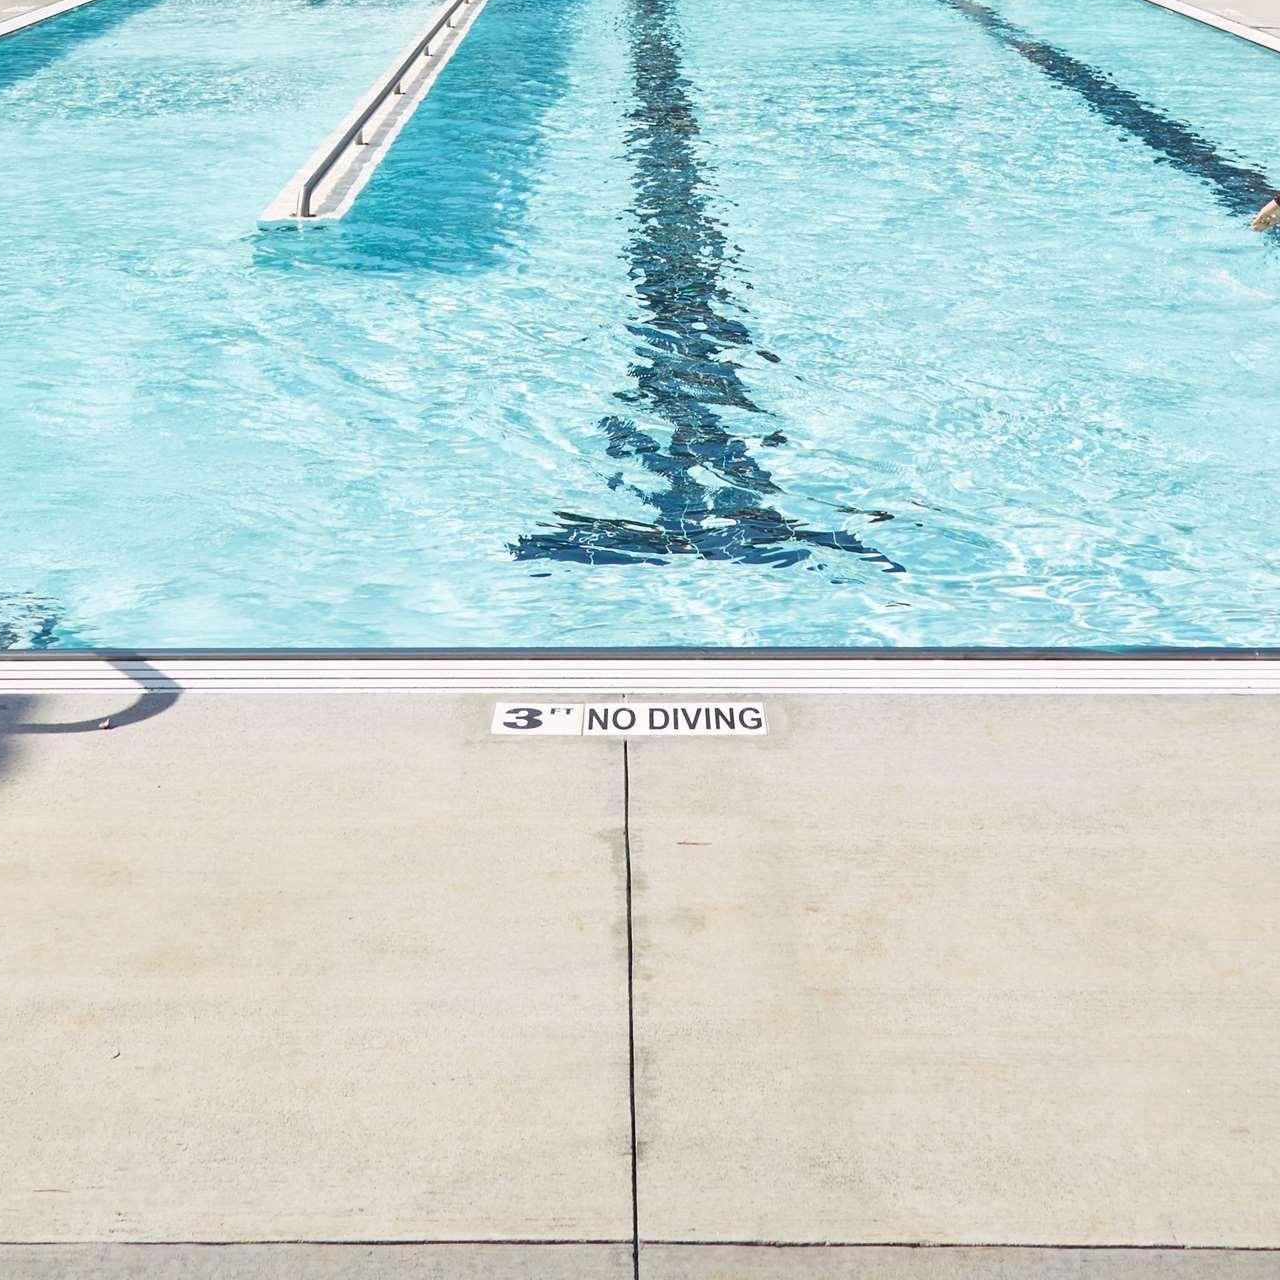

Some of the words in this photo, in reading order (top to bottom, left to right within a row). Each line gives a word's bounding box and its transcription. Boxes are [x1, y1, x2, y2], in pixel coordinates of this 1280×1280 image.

[502, 707, 543, 730] 3
[549, 707, 575, 715] FT
[587, 707, 637, 730] NO
[648, 707, 764, 730] DIVING
